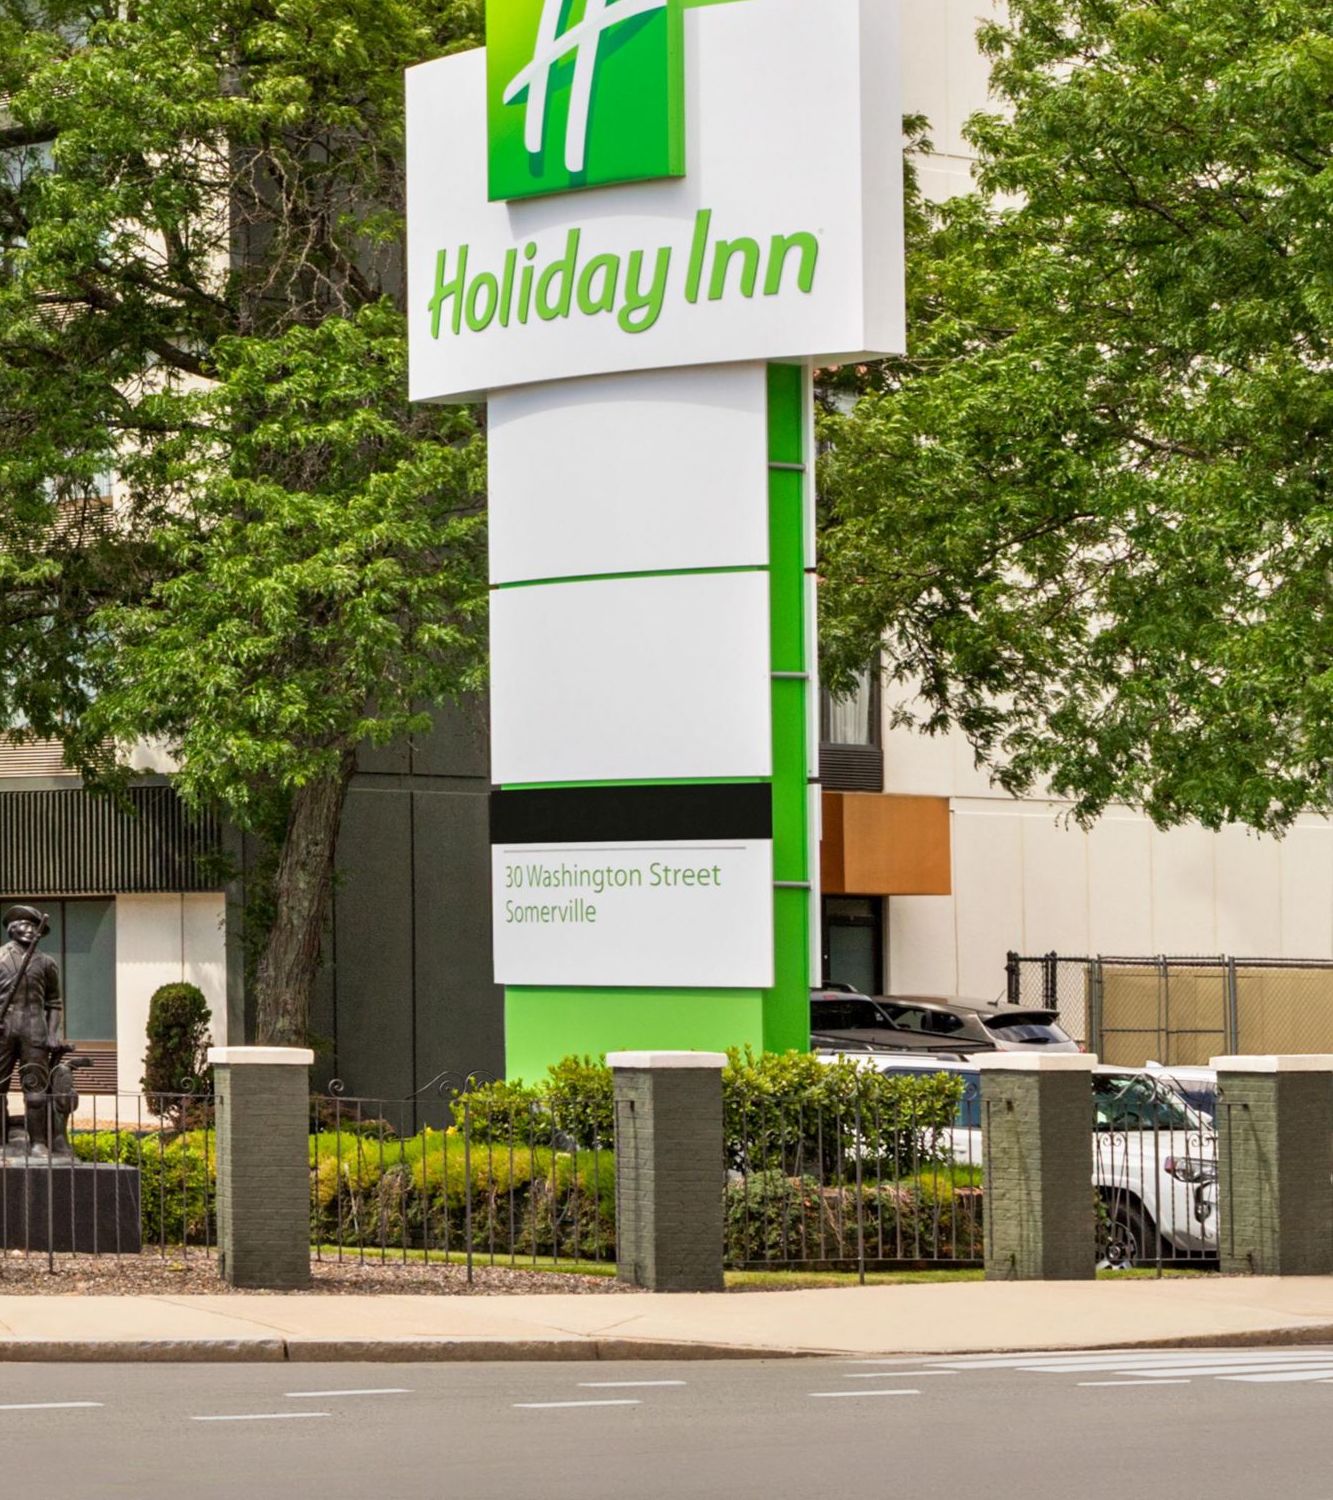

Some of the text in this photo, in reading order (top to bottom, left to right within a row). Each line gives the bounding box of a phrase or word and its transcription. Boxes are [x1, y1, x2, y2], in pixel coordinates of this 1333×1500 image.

[428, 208, 819, 340] Holiday Inn
[505, 862, 722, 893] 30 Washington Street
[505, 898, 597, 923] Somerville
